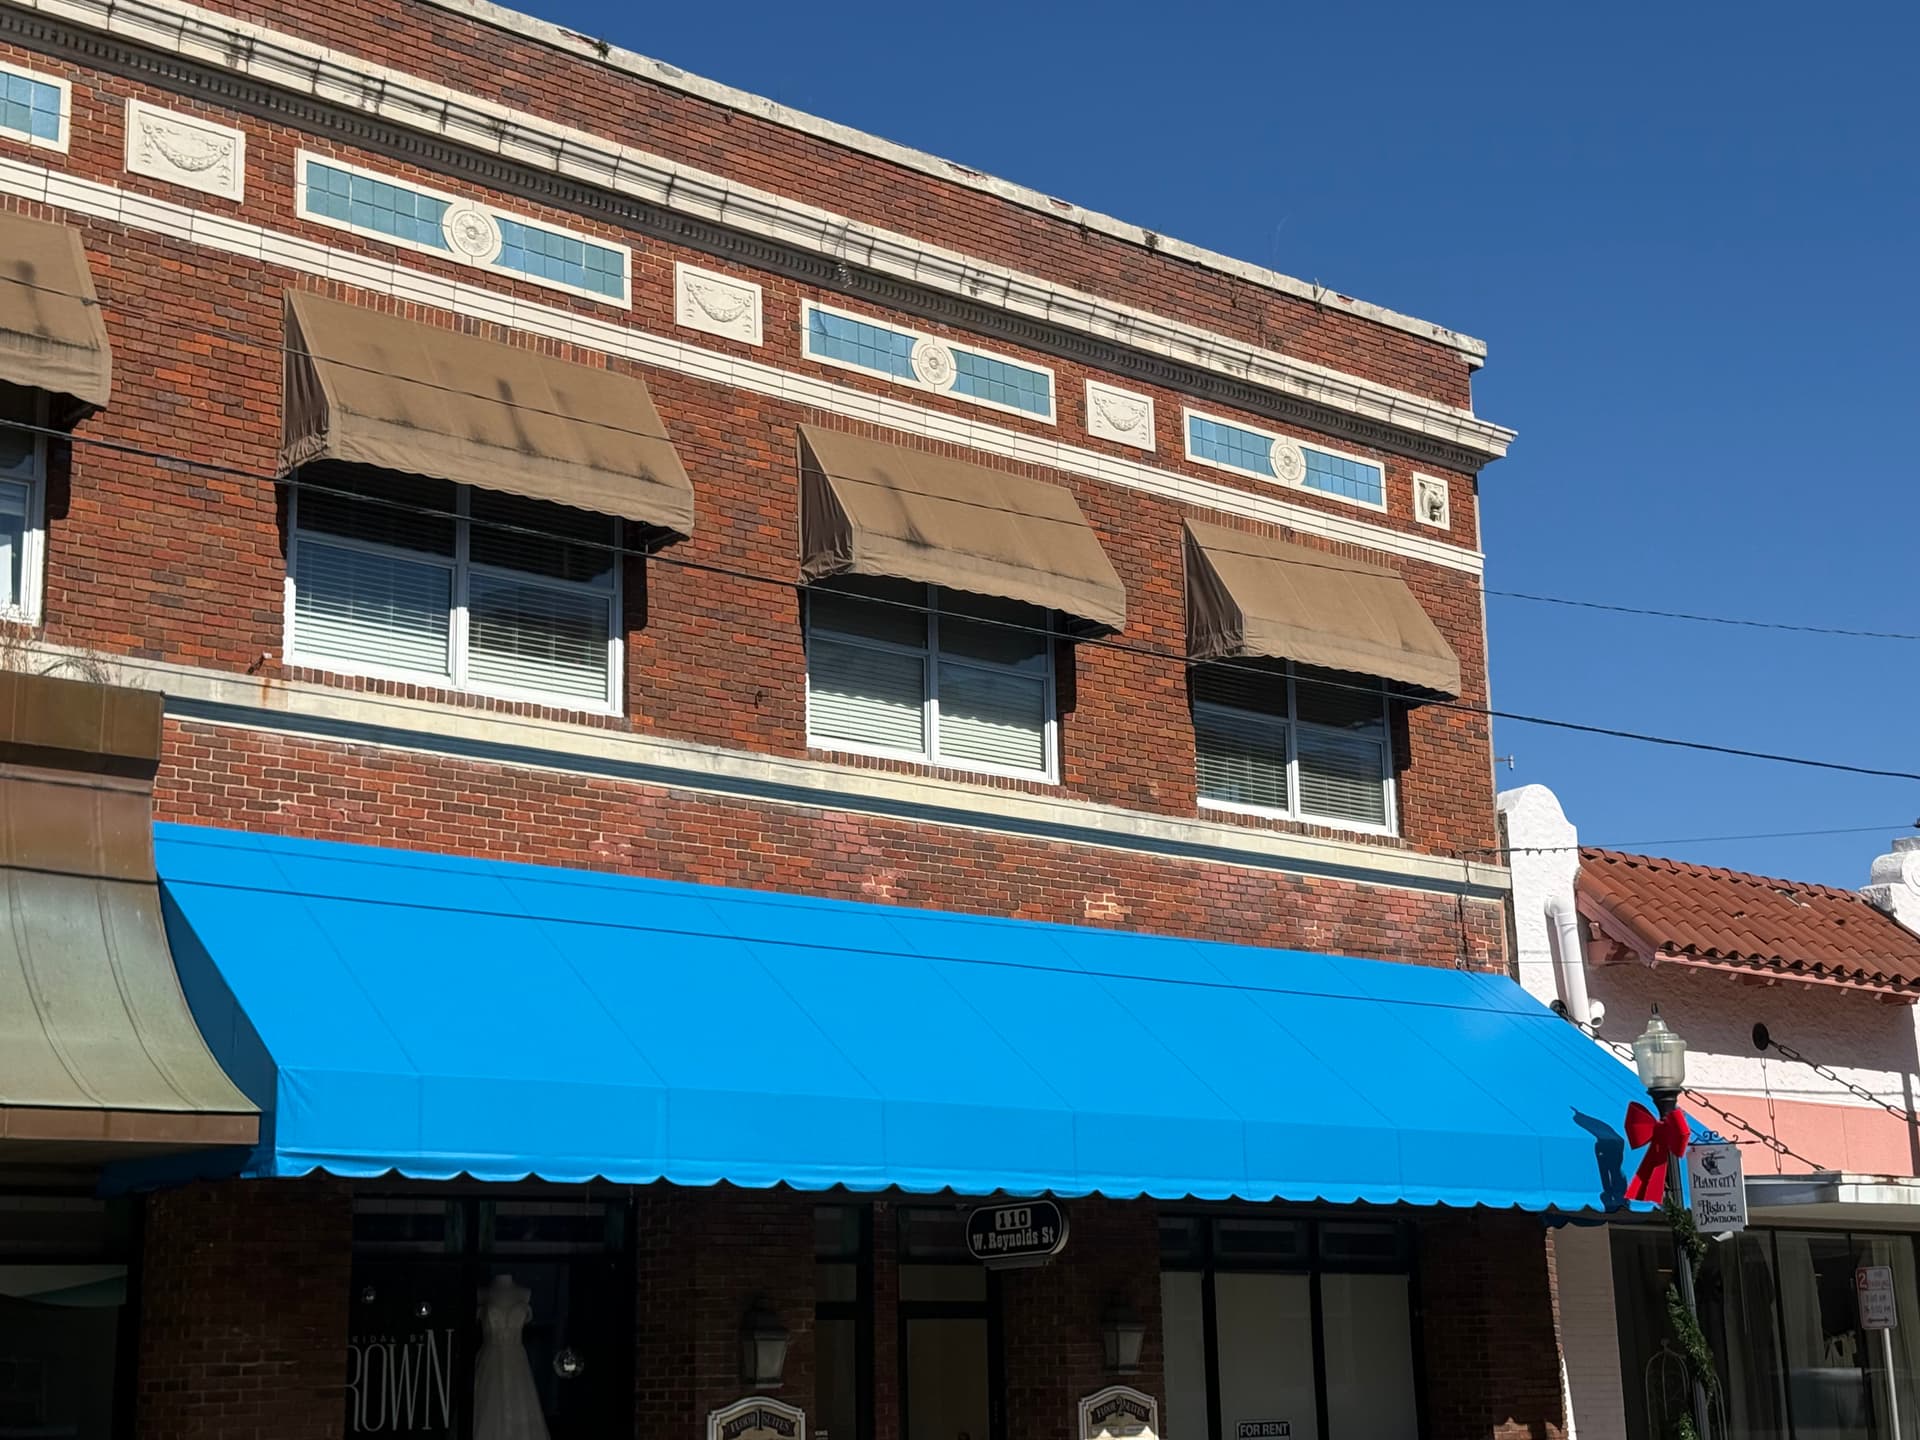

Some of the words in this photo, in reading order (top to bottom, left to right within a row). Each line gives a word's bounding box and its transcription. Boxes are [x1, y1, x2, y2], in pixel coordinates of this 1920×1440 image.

[1693, 1173, 1717, 1188] PLANT
[1718, 1171, 1737, 1187] CITY
[1697, 1199, 1737, 1215] Histoic
[1000, 1209, 1026, 1227] 110
[973, 1233, 987, 1251] W.
[988, 1228, 1039, 1251] Reynolds
[1042, 1226, 1054, 1244] St
[1240, 1424, 1261, 1437] FOR
[1262, 1423, 1288, 1436] RENT
